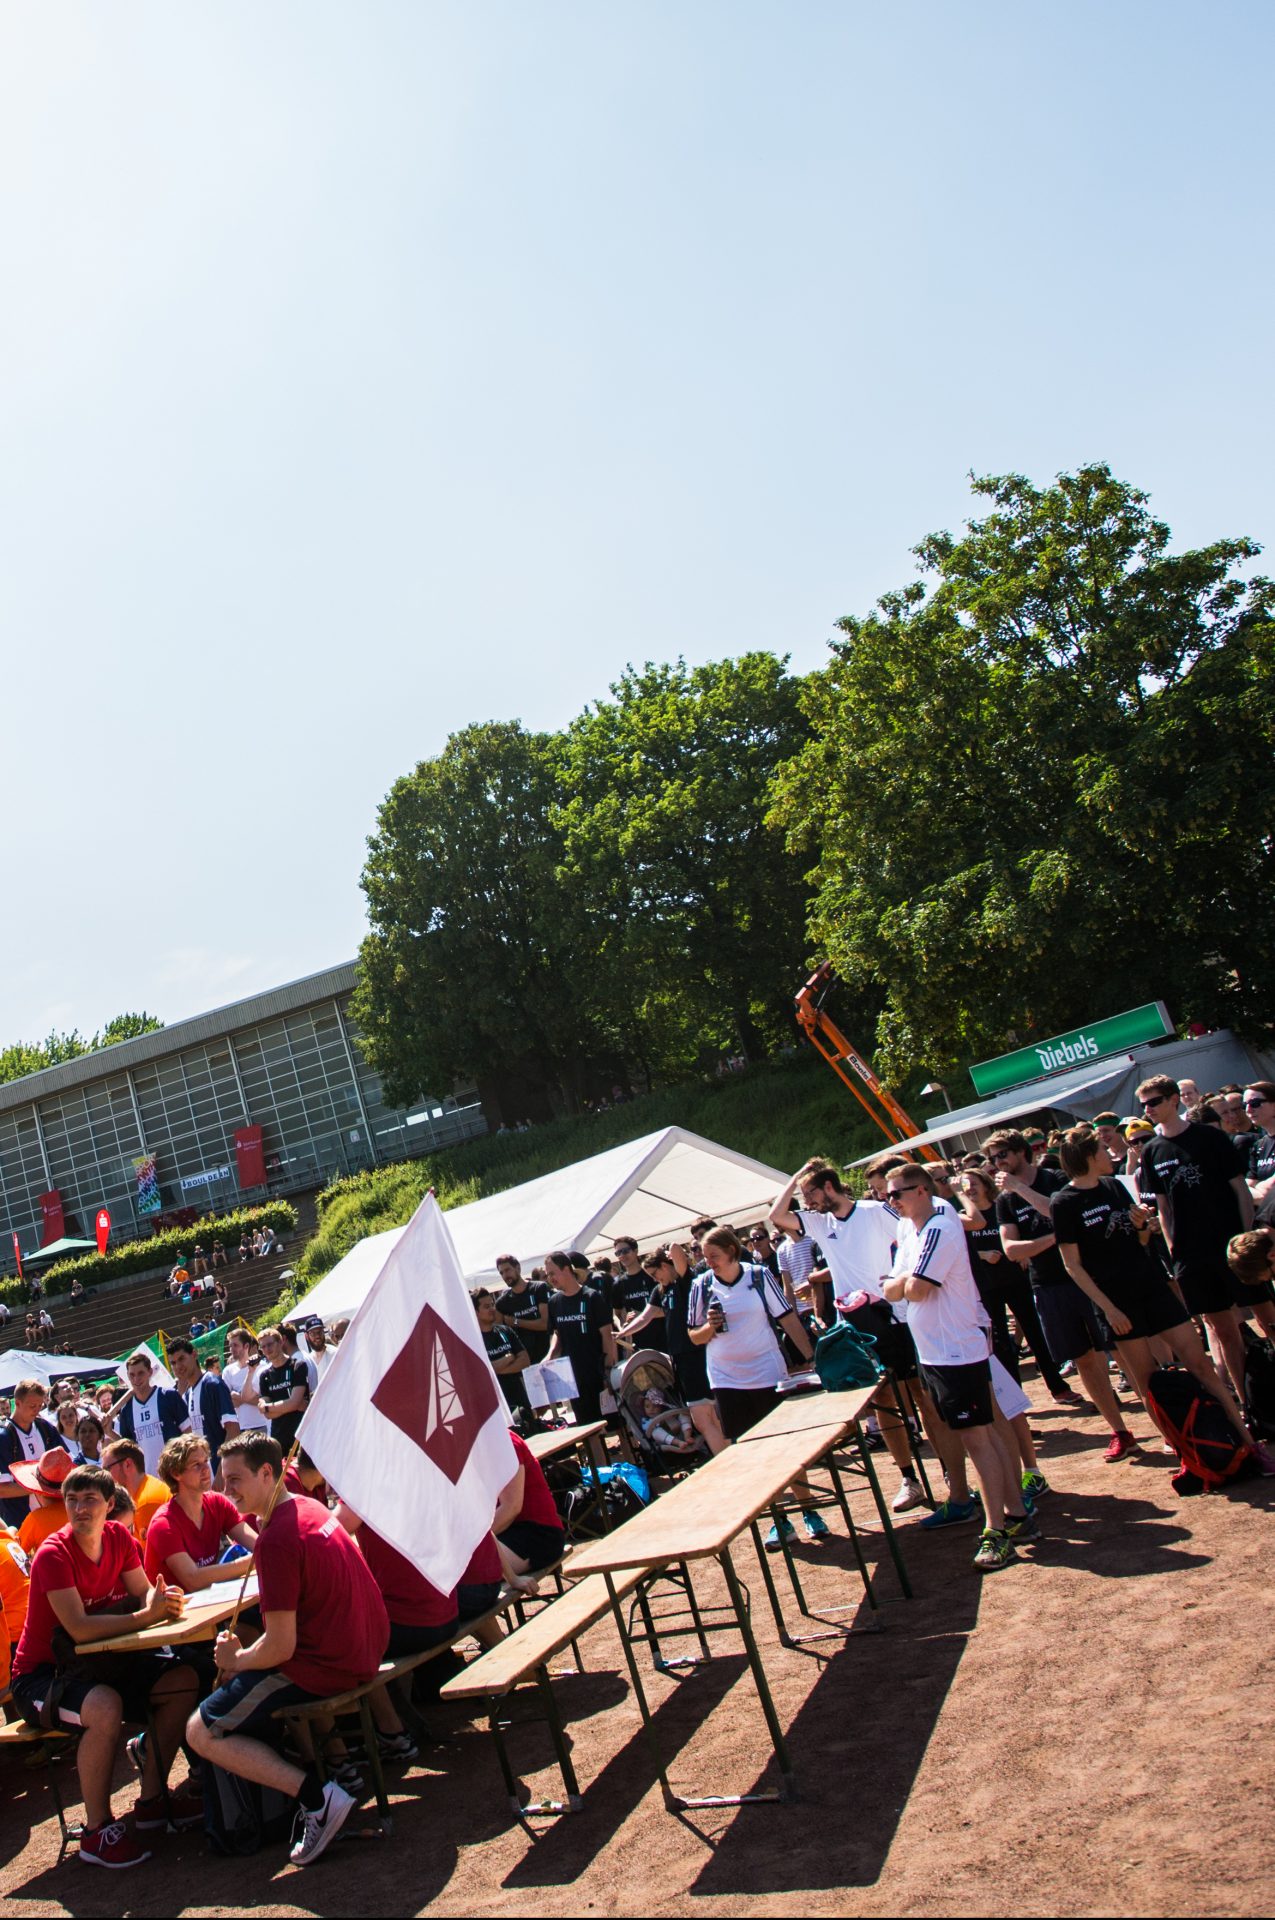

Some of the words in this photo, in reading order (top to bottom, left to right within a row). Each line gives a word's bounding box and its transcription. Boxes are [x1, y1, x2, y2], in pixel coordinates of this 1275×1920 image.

[1084, 1216, 1103, 1227] Stars
[982, 1229, 1000, 1237] AACH
[564, 1313, 587, 1322] AACHEN
[140, 1410, 151, 1423] 15
[28, 1442, 35, 1455] 9
